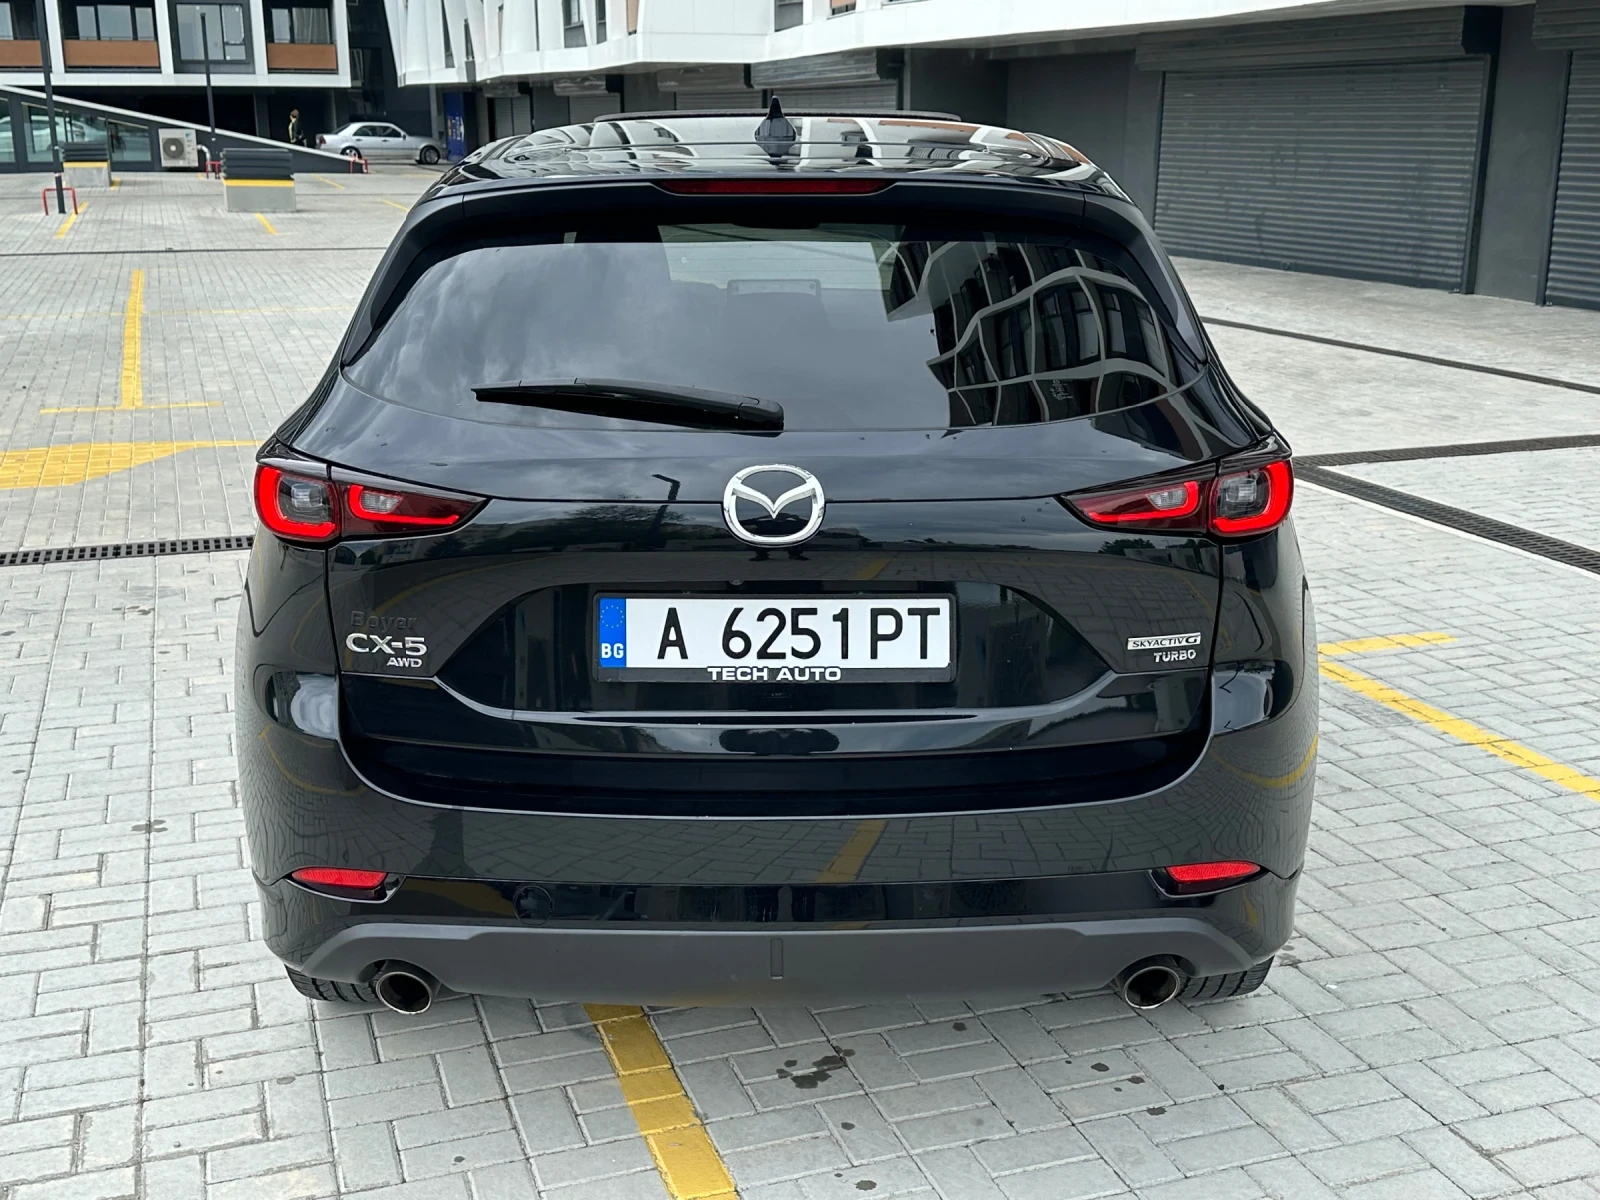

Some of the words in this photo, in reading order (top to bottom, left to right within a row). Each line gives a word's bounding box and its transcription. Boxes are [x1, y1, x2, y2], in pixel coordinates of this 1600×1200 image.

[657, 607, 689, 660] A
[721, 607, 850, 660] 6251
[869, 607, 941, 660] PT
[345, 632, 428, 656] CX-5
[600, 643, 624, 659] BG
[386, 657, 423, 668] AWD
[1153, 649, 1197, 663] TURBO
[706, 667, 769, 682] TECH
[775, 667, 842, 682] AUTO
